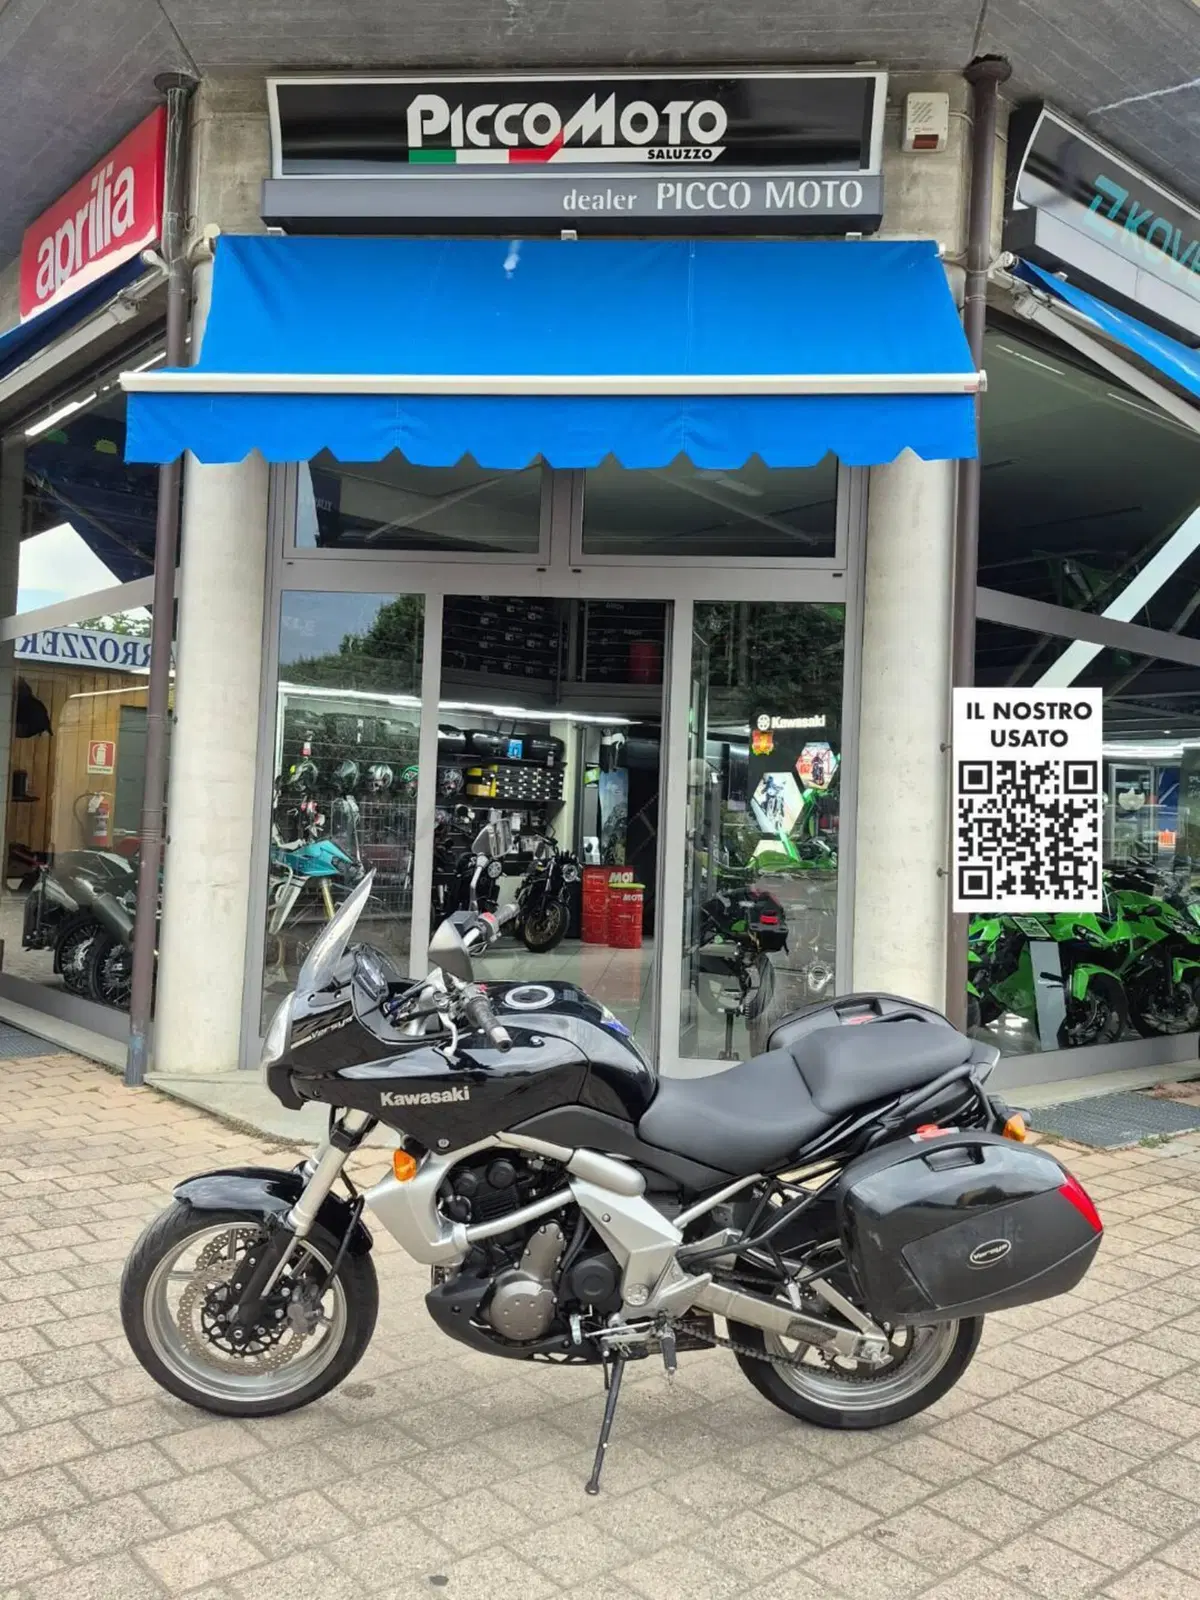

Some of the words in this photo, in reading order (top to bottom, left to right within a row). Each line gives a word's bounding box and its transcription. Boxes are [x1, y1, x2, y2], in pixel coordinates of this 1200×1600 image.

[647, 148, 713, 160] SALUZZO
[563, 189, 638, 210] dealer
[657, 181, 751, 210] PICCO
[765, 180, 863, 209] MOTO
[36, 161, 135, 299] aprilia
[771, 714, 826, 729] Kawasaki
[380, 1085, 470, 1106] Kawasaki
